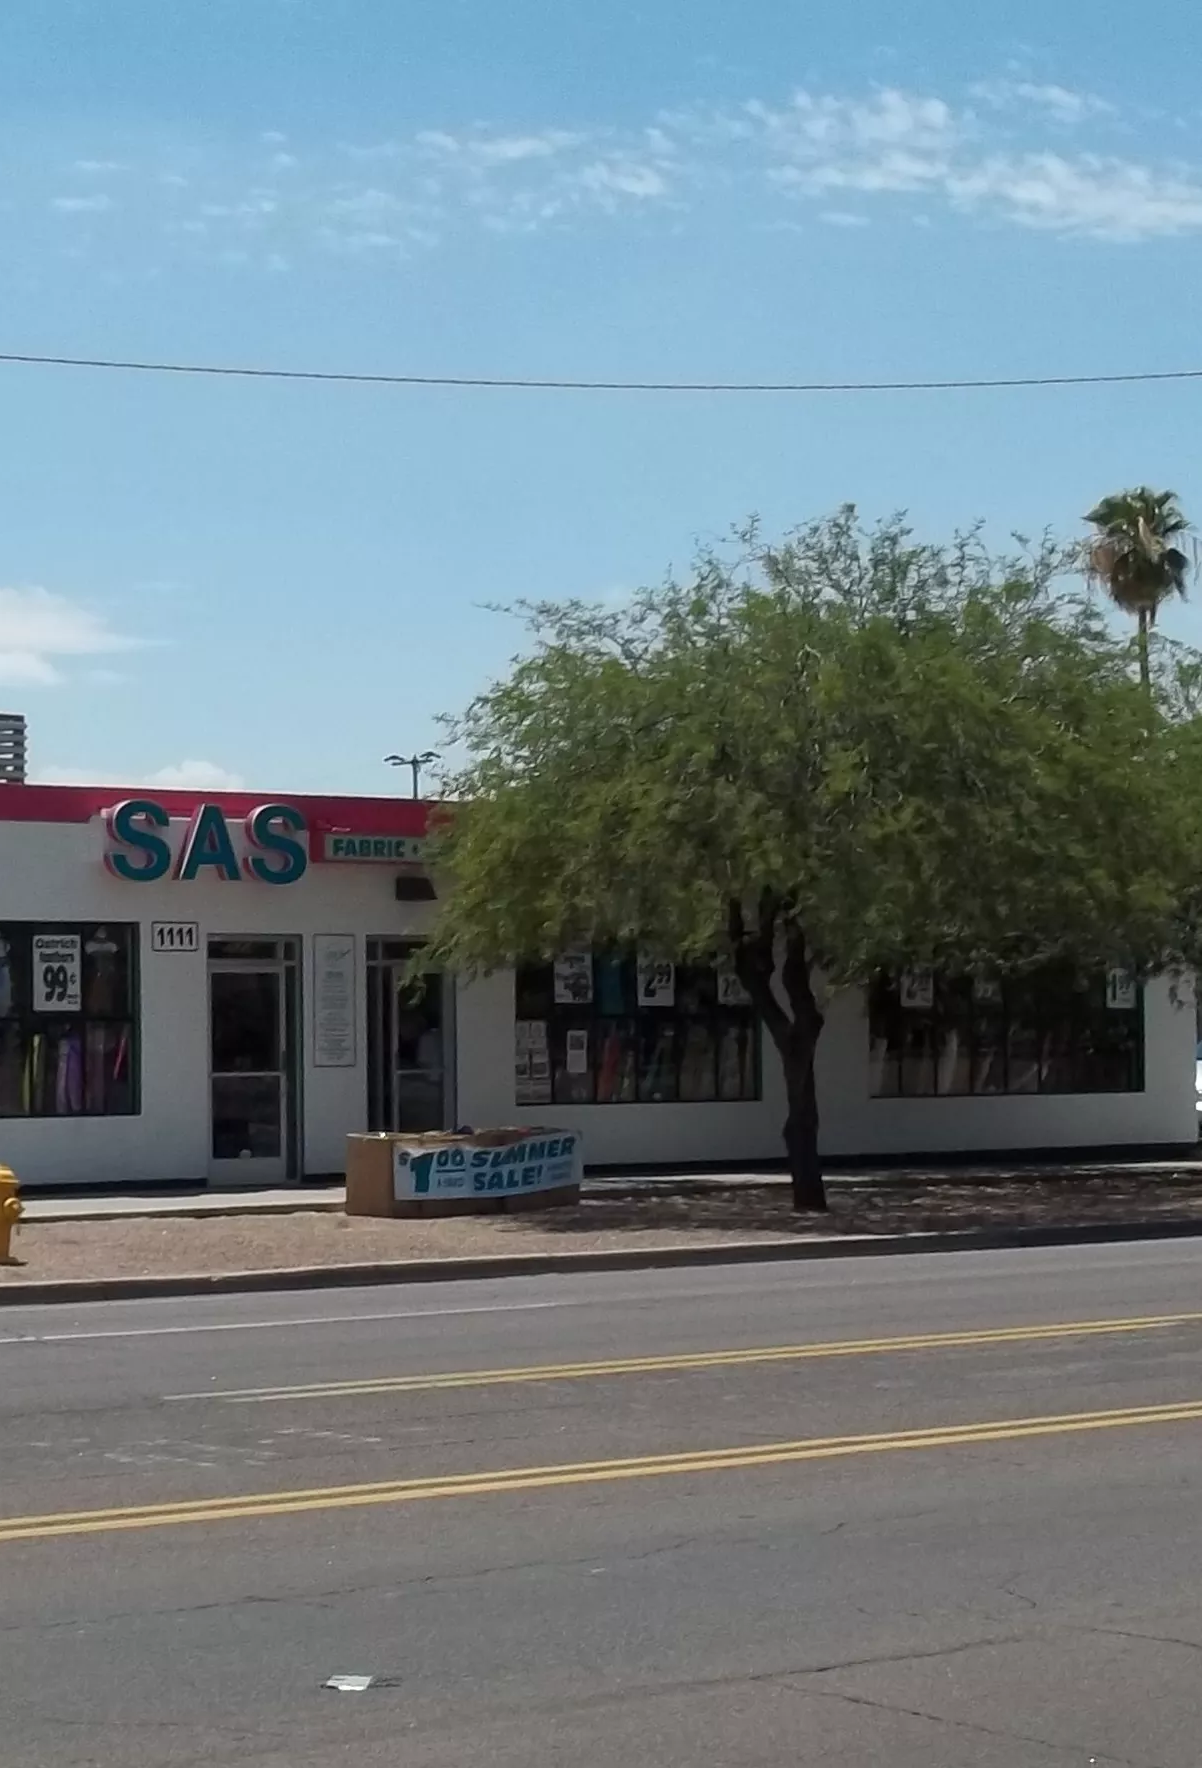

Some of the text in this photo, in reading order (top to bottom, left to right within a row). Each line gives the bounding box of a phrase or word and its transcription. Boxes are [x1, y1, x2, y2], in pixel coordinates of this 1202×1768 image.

[104, 799, 309, 885] SAS
[332, 838, 406, 858] FABRIC
[156, 926, 195, 947] 1111
[470, 1136, 576, 1168] SUMMER
[473, 1165, 543, 1191] SALE!
